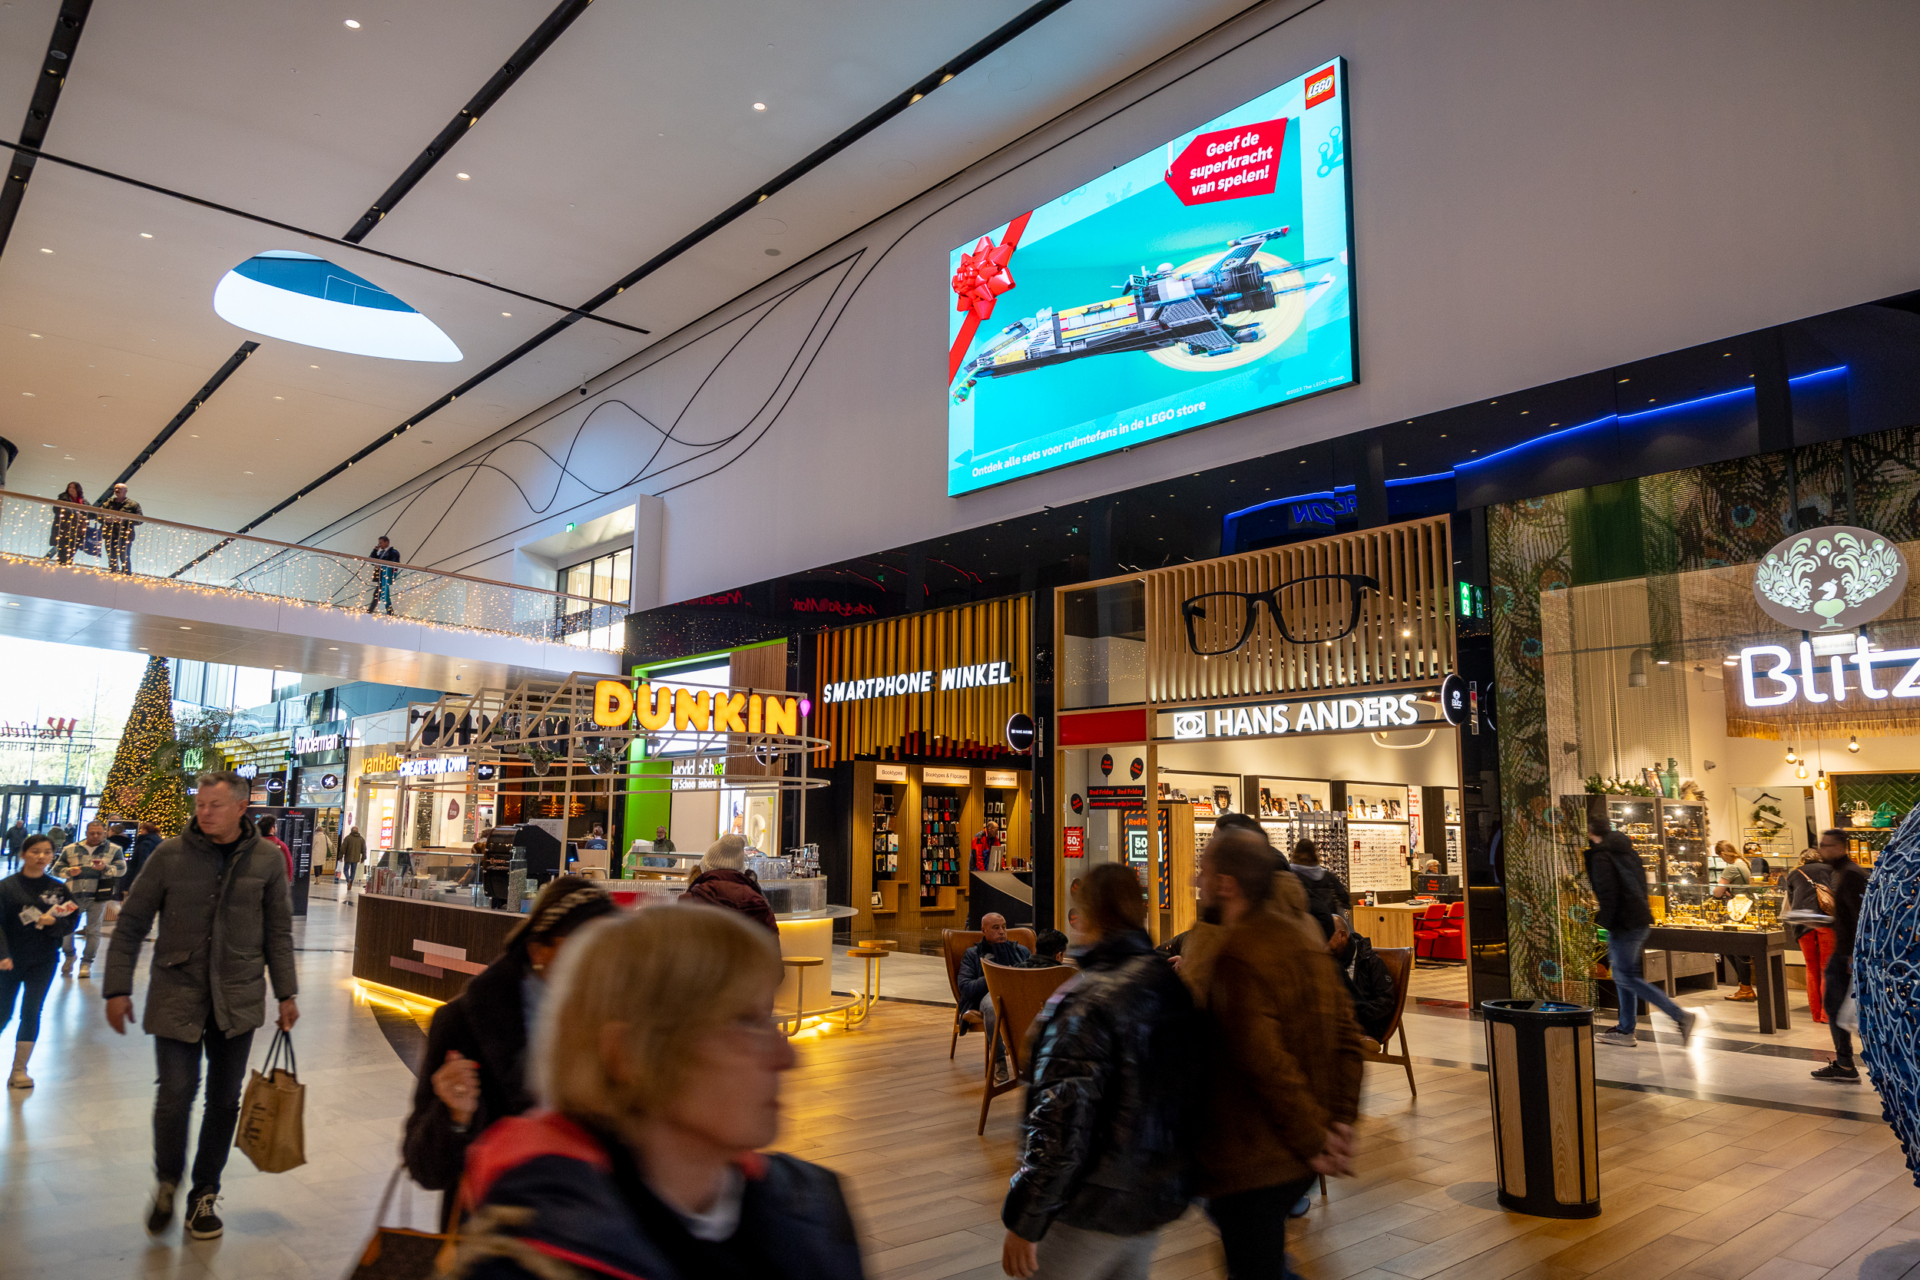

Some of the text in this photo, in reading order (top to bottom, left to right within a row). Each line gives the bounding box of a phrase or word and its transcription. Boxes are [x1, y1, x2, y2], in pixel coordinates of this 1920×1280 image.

[1306, 75, 1333, 100] LEGO
[1206, 131, 1260, 157] Geef de
[1189, 146, 1273, 179] superkracht
[1191, 164, 1270, 196] van spelen!
[972, 401, 1206, 477] Ontdek alle sets voor ruimtefans in de LEGO store
[823, 661, 1012, 704] SMARTPHONE WINKEL
[1740, 635, 1920, 707] Blitz
[1214, 694, 1419, 737] HANS ANDERS
[361, 752, 409, 774] vanHare
[679, 778, 717, 790] Schooenberg
[1128, 818, 1140, 826] Red
[1134, 837, 1148, 848] 50
[1134, 847, 1148, 855] kort
